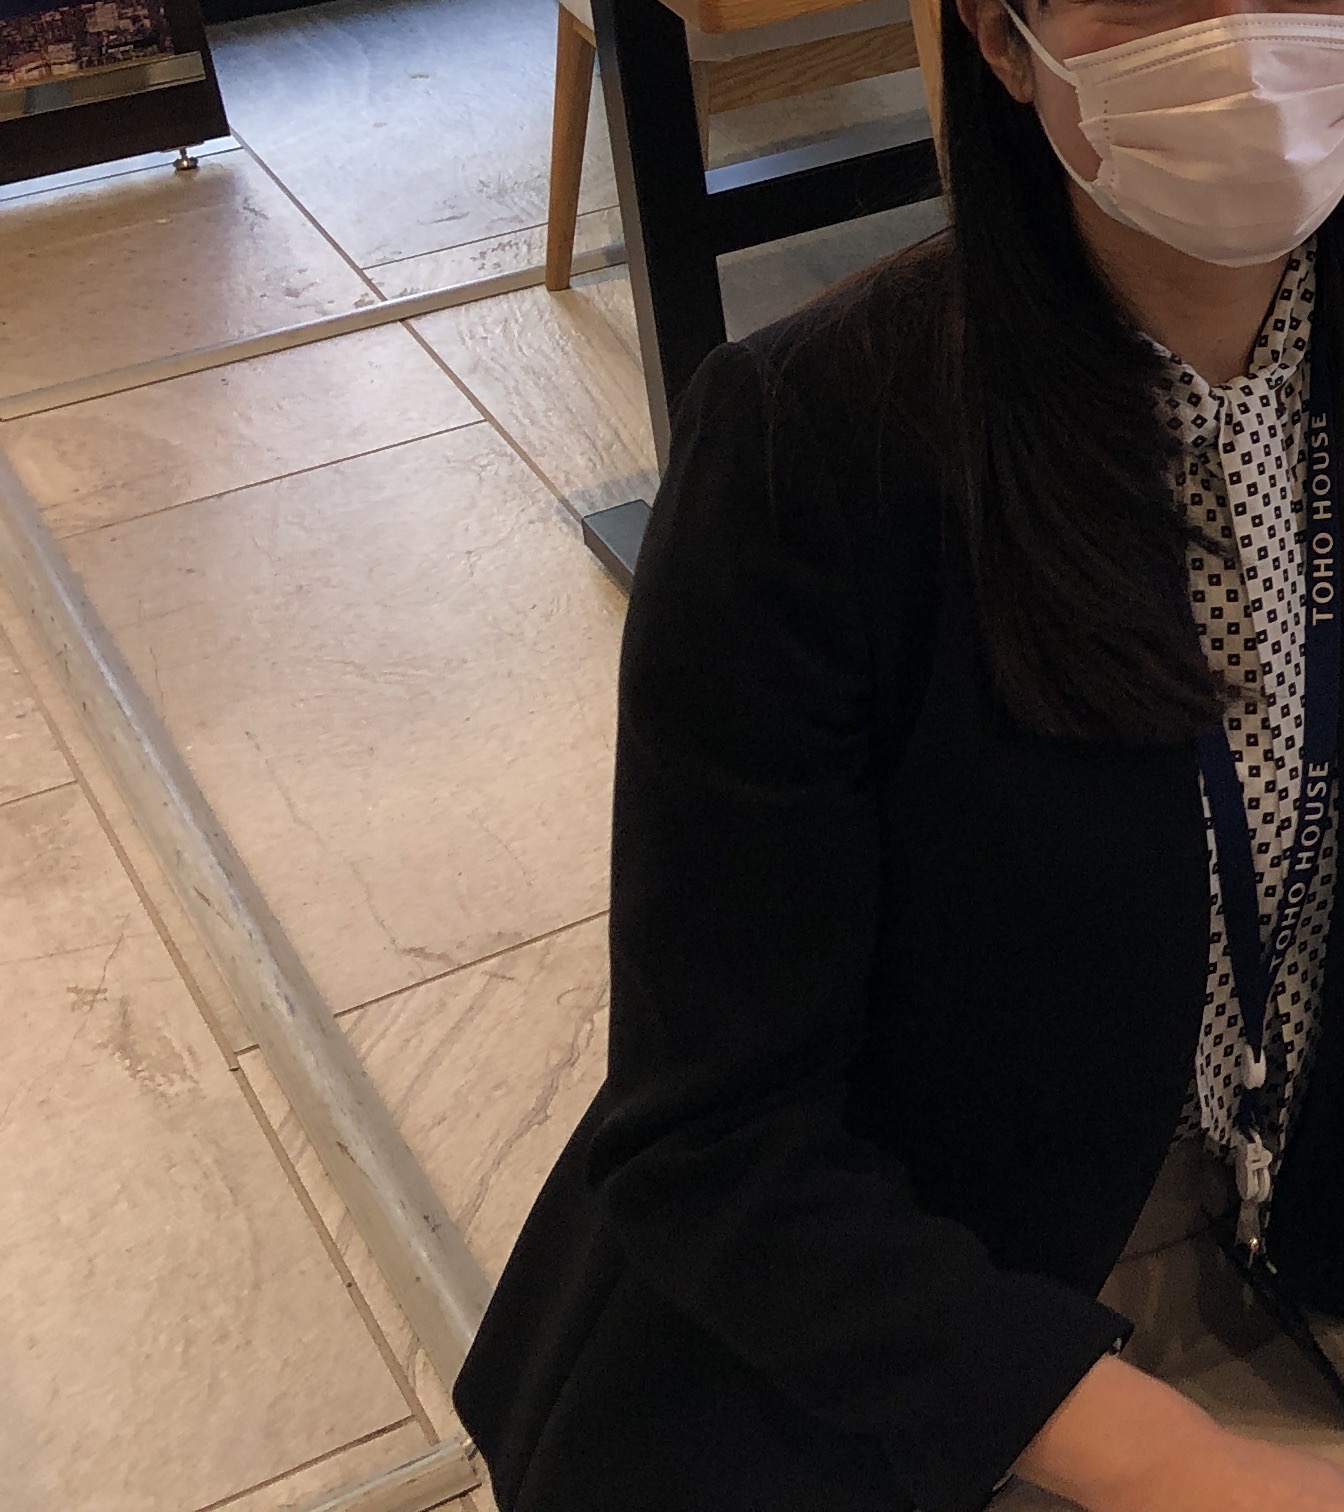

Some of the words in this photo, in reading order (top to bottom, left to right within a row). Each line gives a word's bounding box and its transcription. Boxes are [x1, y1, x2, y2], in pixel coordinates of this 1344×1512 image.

[1311, 412, 1333, 520] HOUSE
[1312, 532, 1334, 626] TOHO
[1294, 761, 1329, 871] HOUSE
